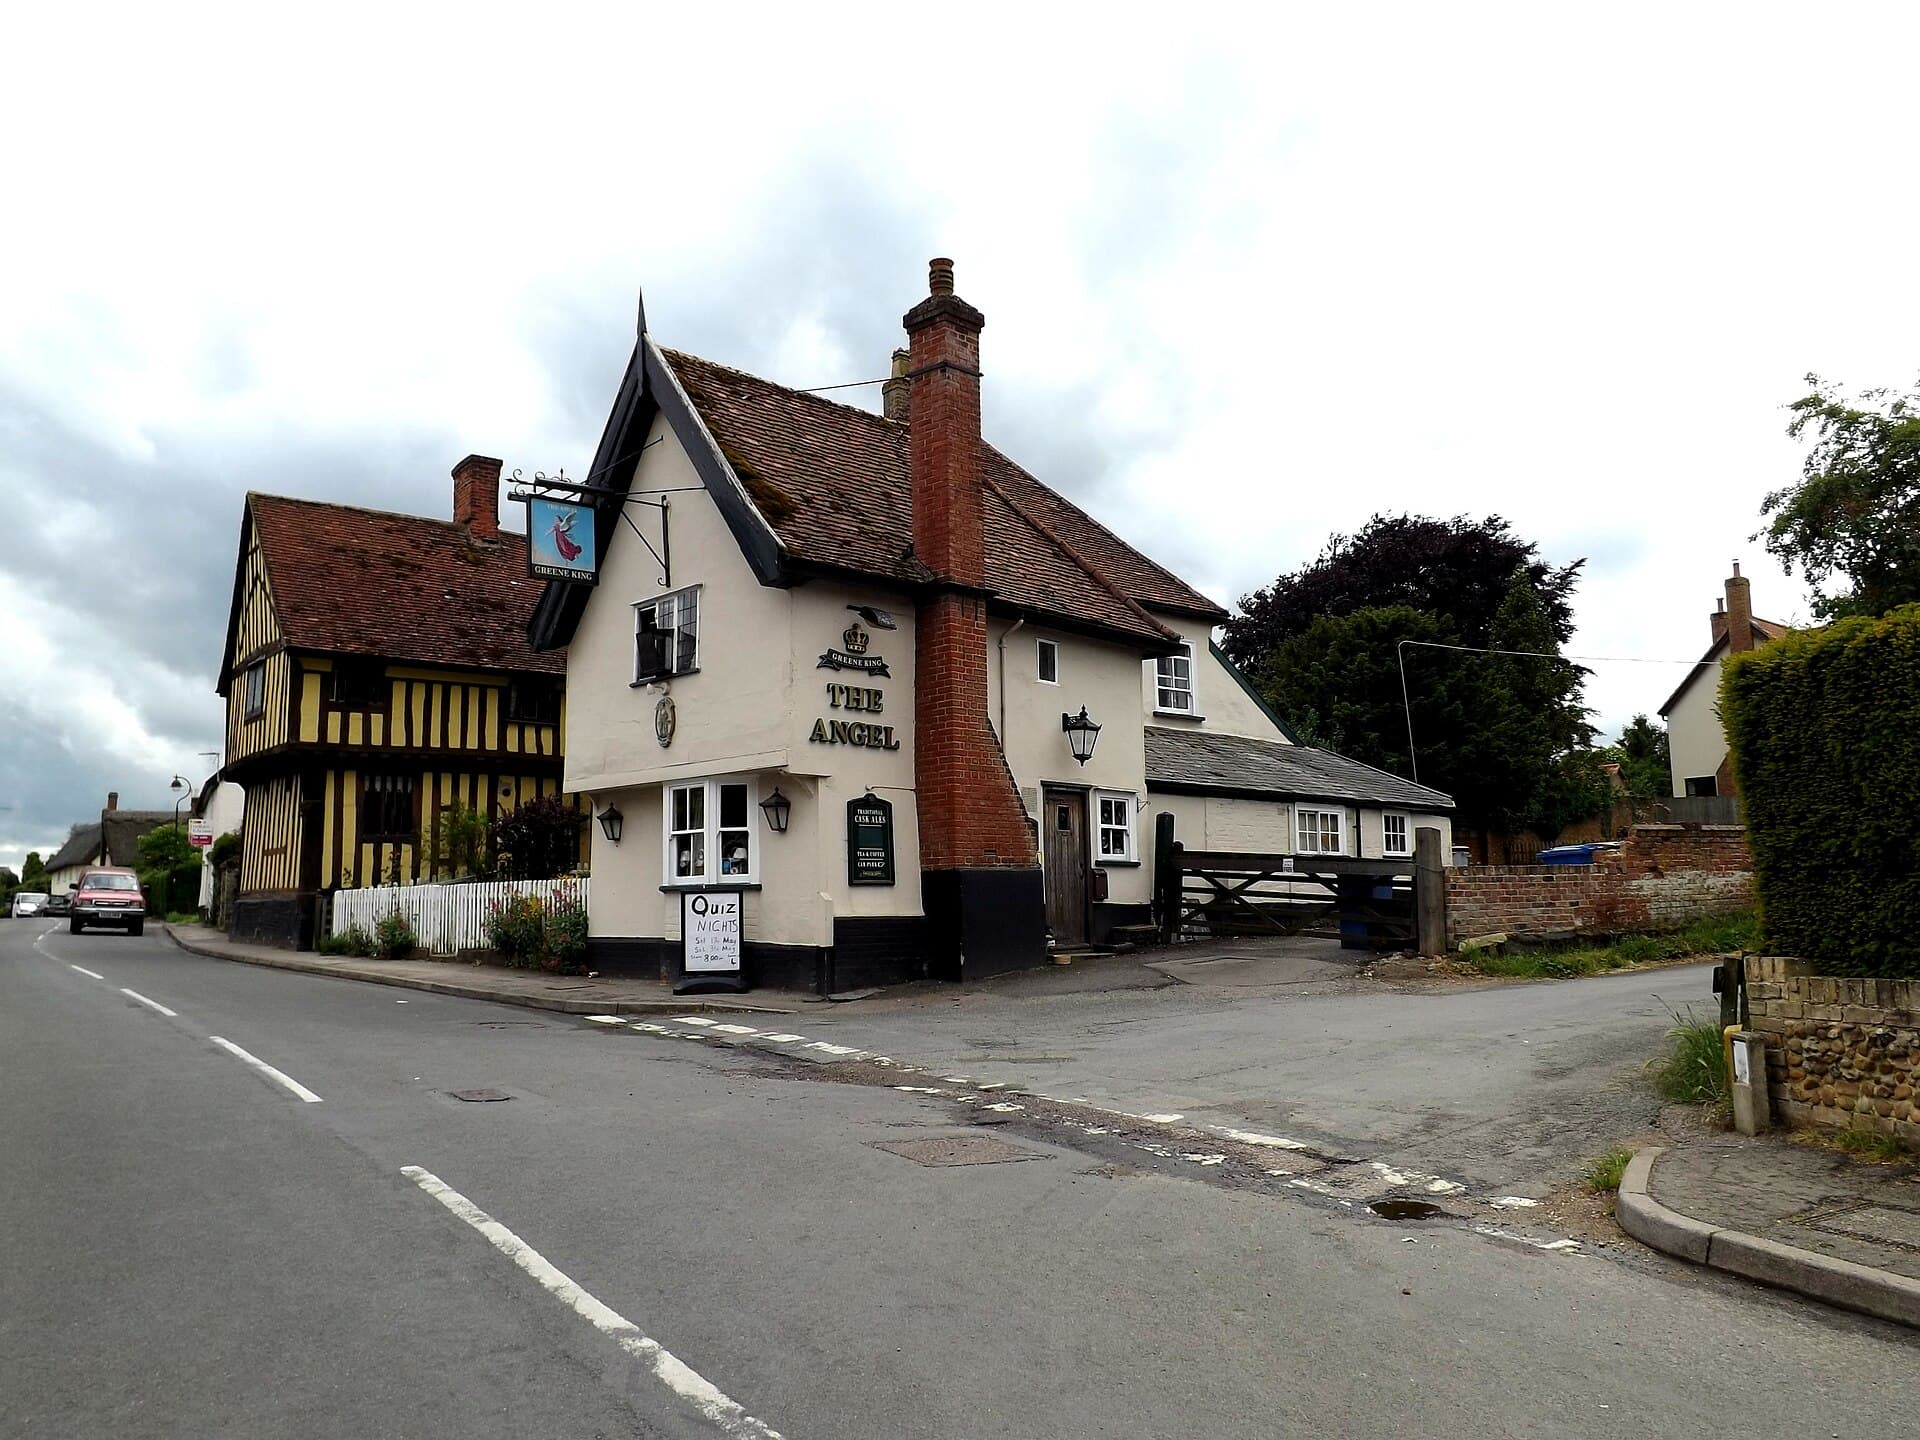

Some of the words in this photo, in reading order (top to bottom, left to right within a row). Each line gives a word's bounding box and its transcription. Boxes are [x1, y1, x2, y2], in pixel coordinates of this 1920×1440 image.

[534, 566, 570, 577] GREENE
[571, 571, 593, 580] KING
[832, 653, 863, 667] GREENE
[864, 659, 882, 667] KING
[827, 683, 883, 712] THE
[809, 718, 900, 750] ANGEL
[870, 815, 886, 824] ALES
